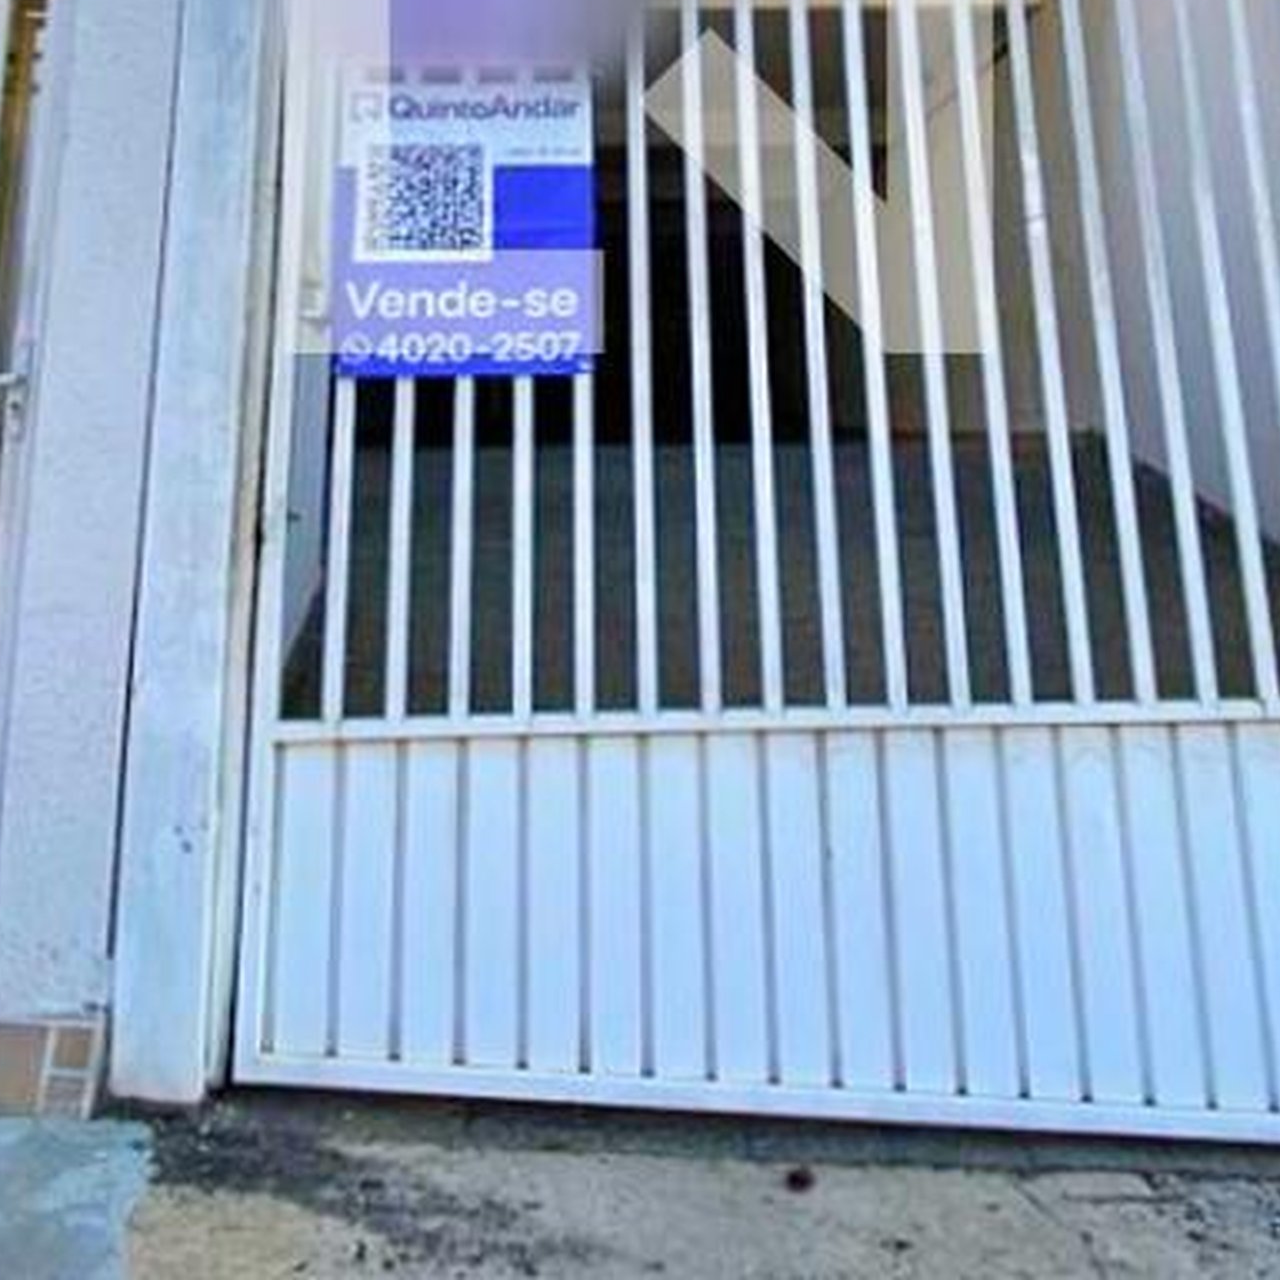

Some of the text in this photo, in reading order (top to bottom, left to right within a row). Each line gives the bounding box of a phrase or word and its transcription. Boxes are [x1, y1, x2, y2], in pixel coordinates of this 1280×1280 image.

[389, 94, 580, 120] QuintoAndar
[346, 281, 578, 318] Vende-se
[376, 333, 581, 362] 4020-2507
